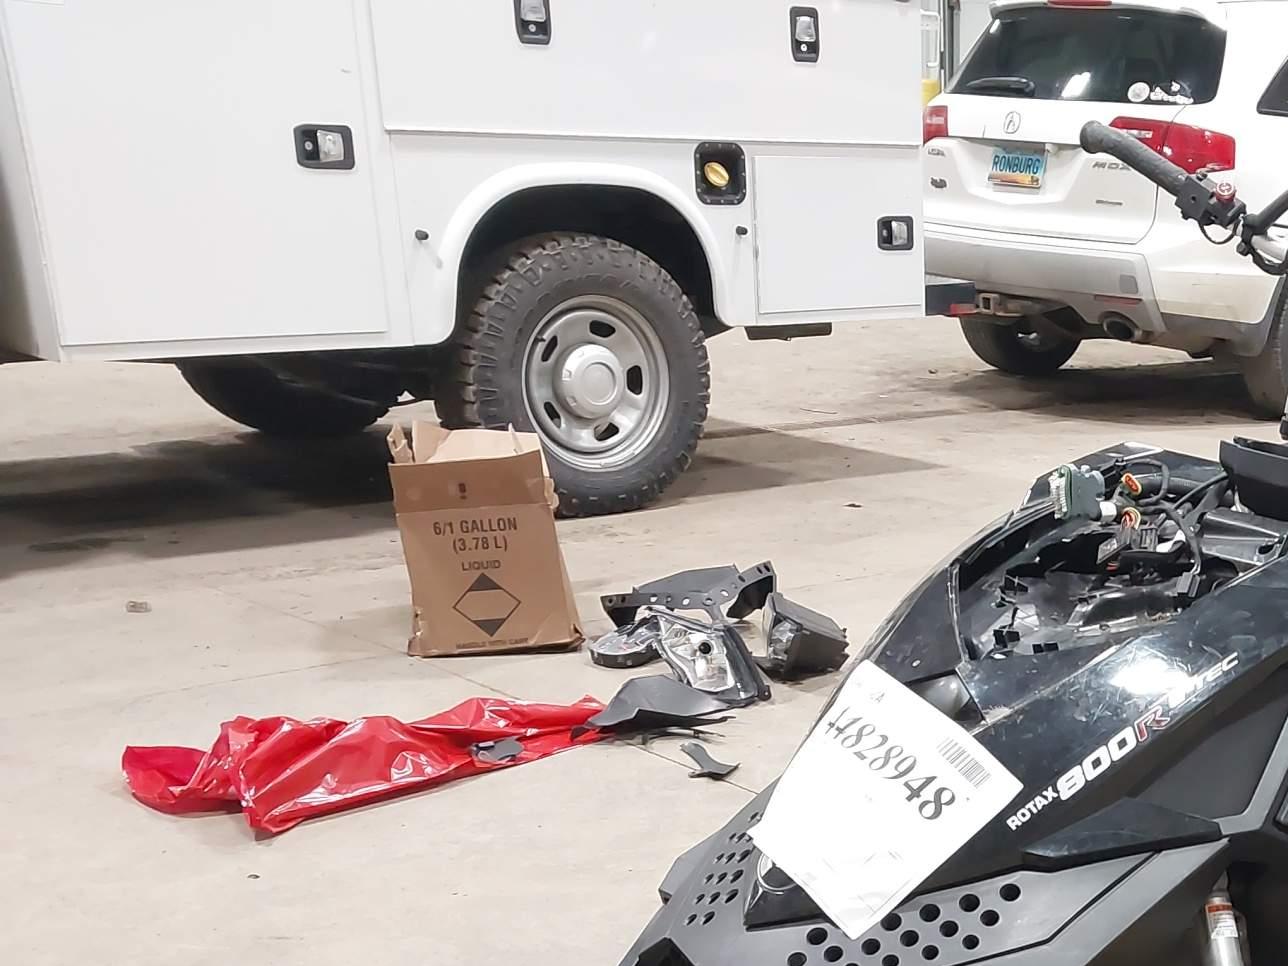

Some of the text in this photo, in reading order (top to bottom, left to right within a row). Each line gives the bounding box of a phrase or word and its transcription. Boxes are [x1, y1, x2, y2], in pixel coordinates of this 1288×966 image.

[992, 154, 1041, 175] RONBURG
[433, 517, 518, 536] 6/1 GALLON
[452, 535, 508, 554] (3.78 L)
[461, 560, 501, 571] LIQUID
[1006, 786, 1059, 831] ROTAX
